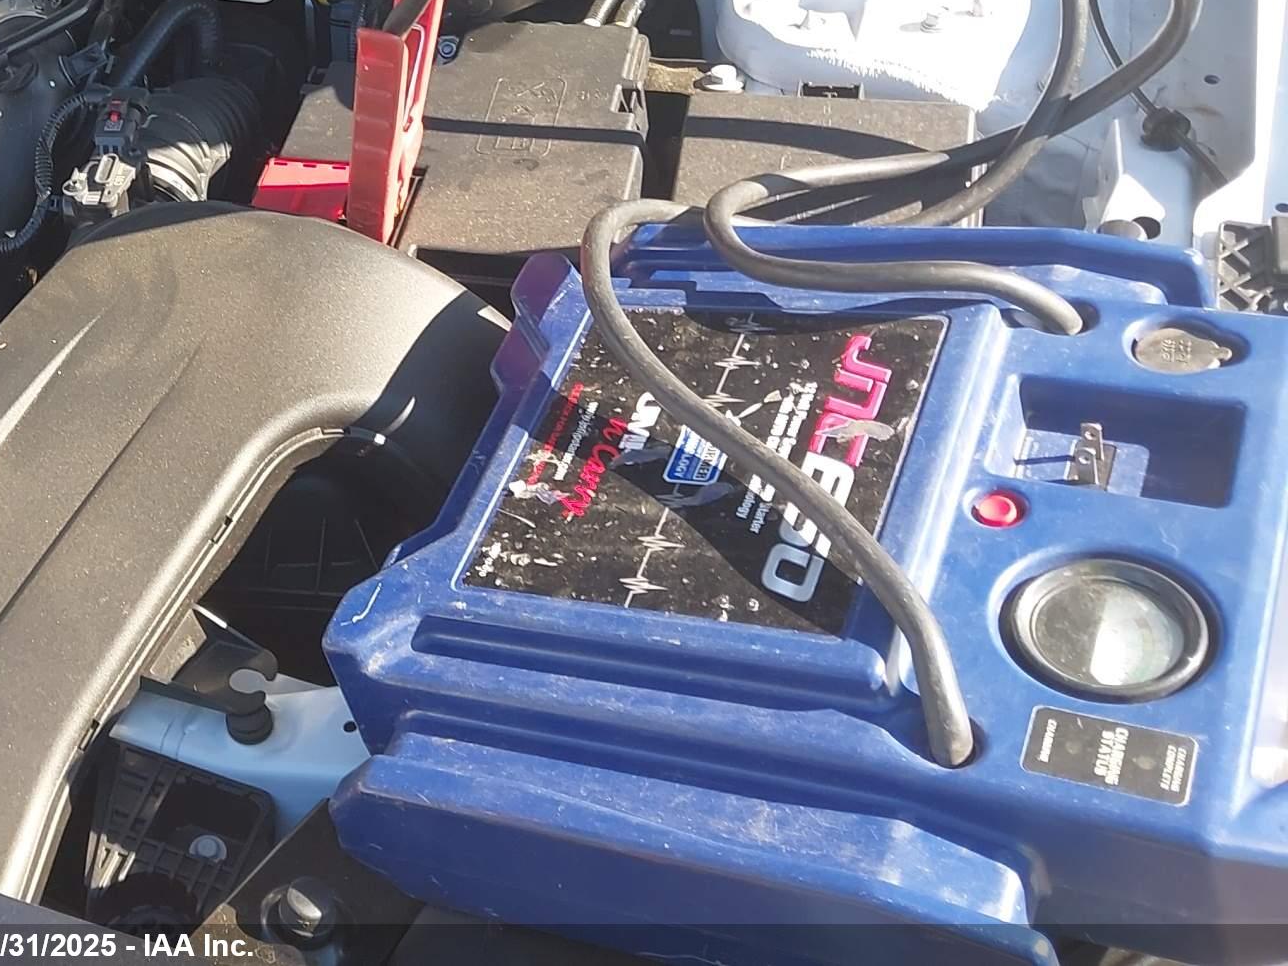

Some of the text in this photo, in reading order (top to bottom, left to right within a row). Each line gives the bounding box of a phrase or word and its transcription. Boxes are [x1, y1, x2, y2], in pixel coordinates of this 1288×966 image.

[1094, 730, 1115, 777] STATUS
[1104, 727, 1129, 786] CHARGING
[1160, 744, 1177, 791] COMPLETE
[1170, 747, 1187, 793] CHARGING
